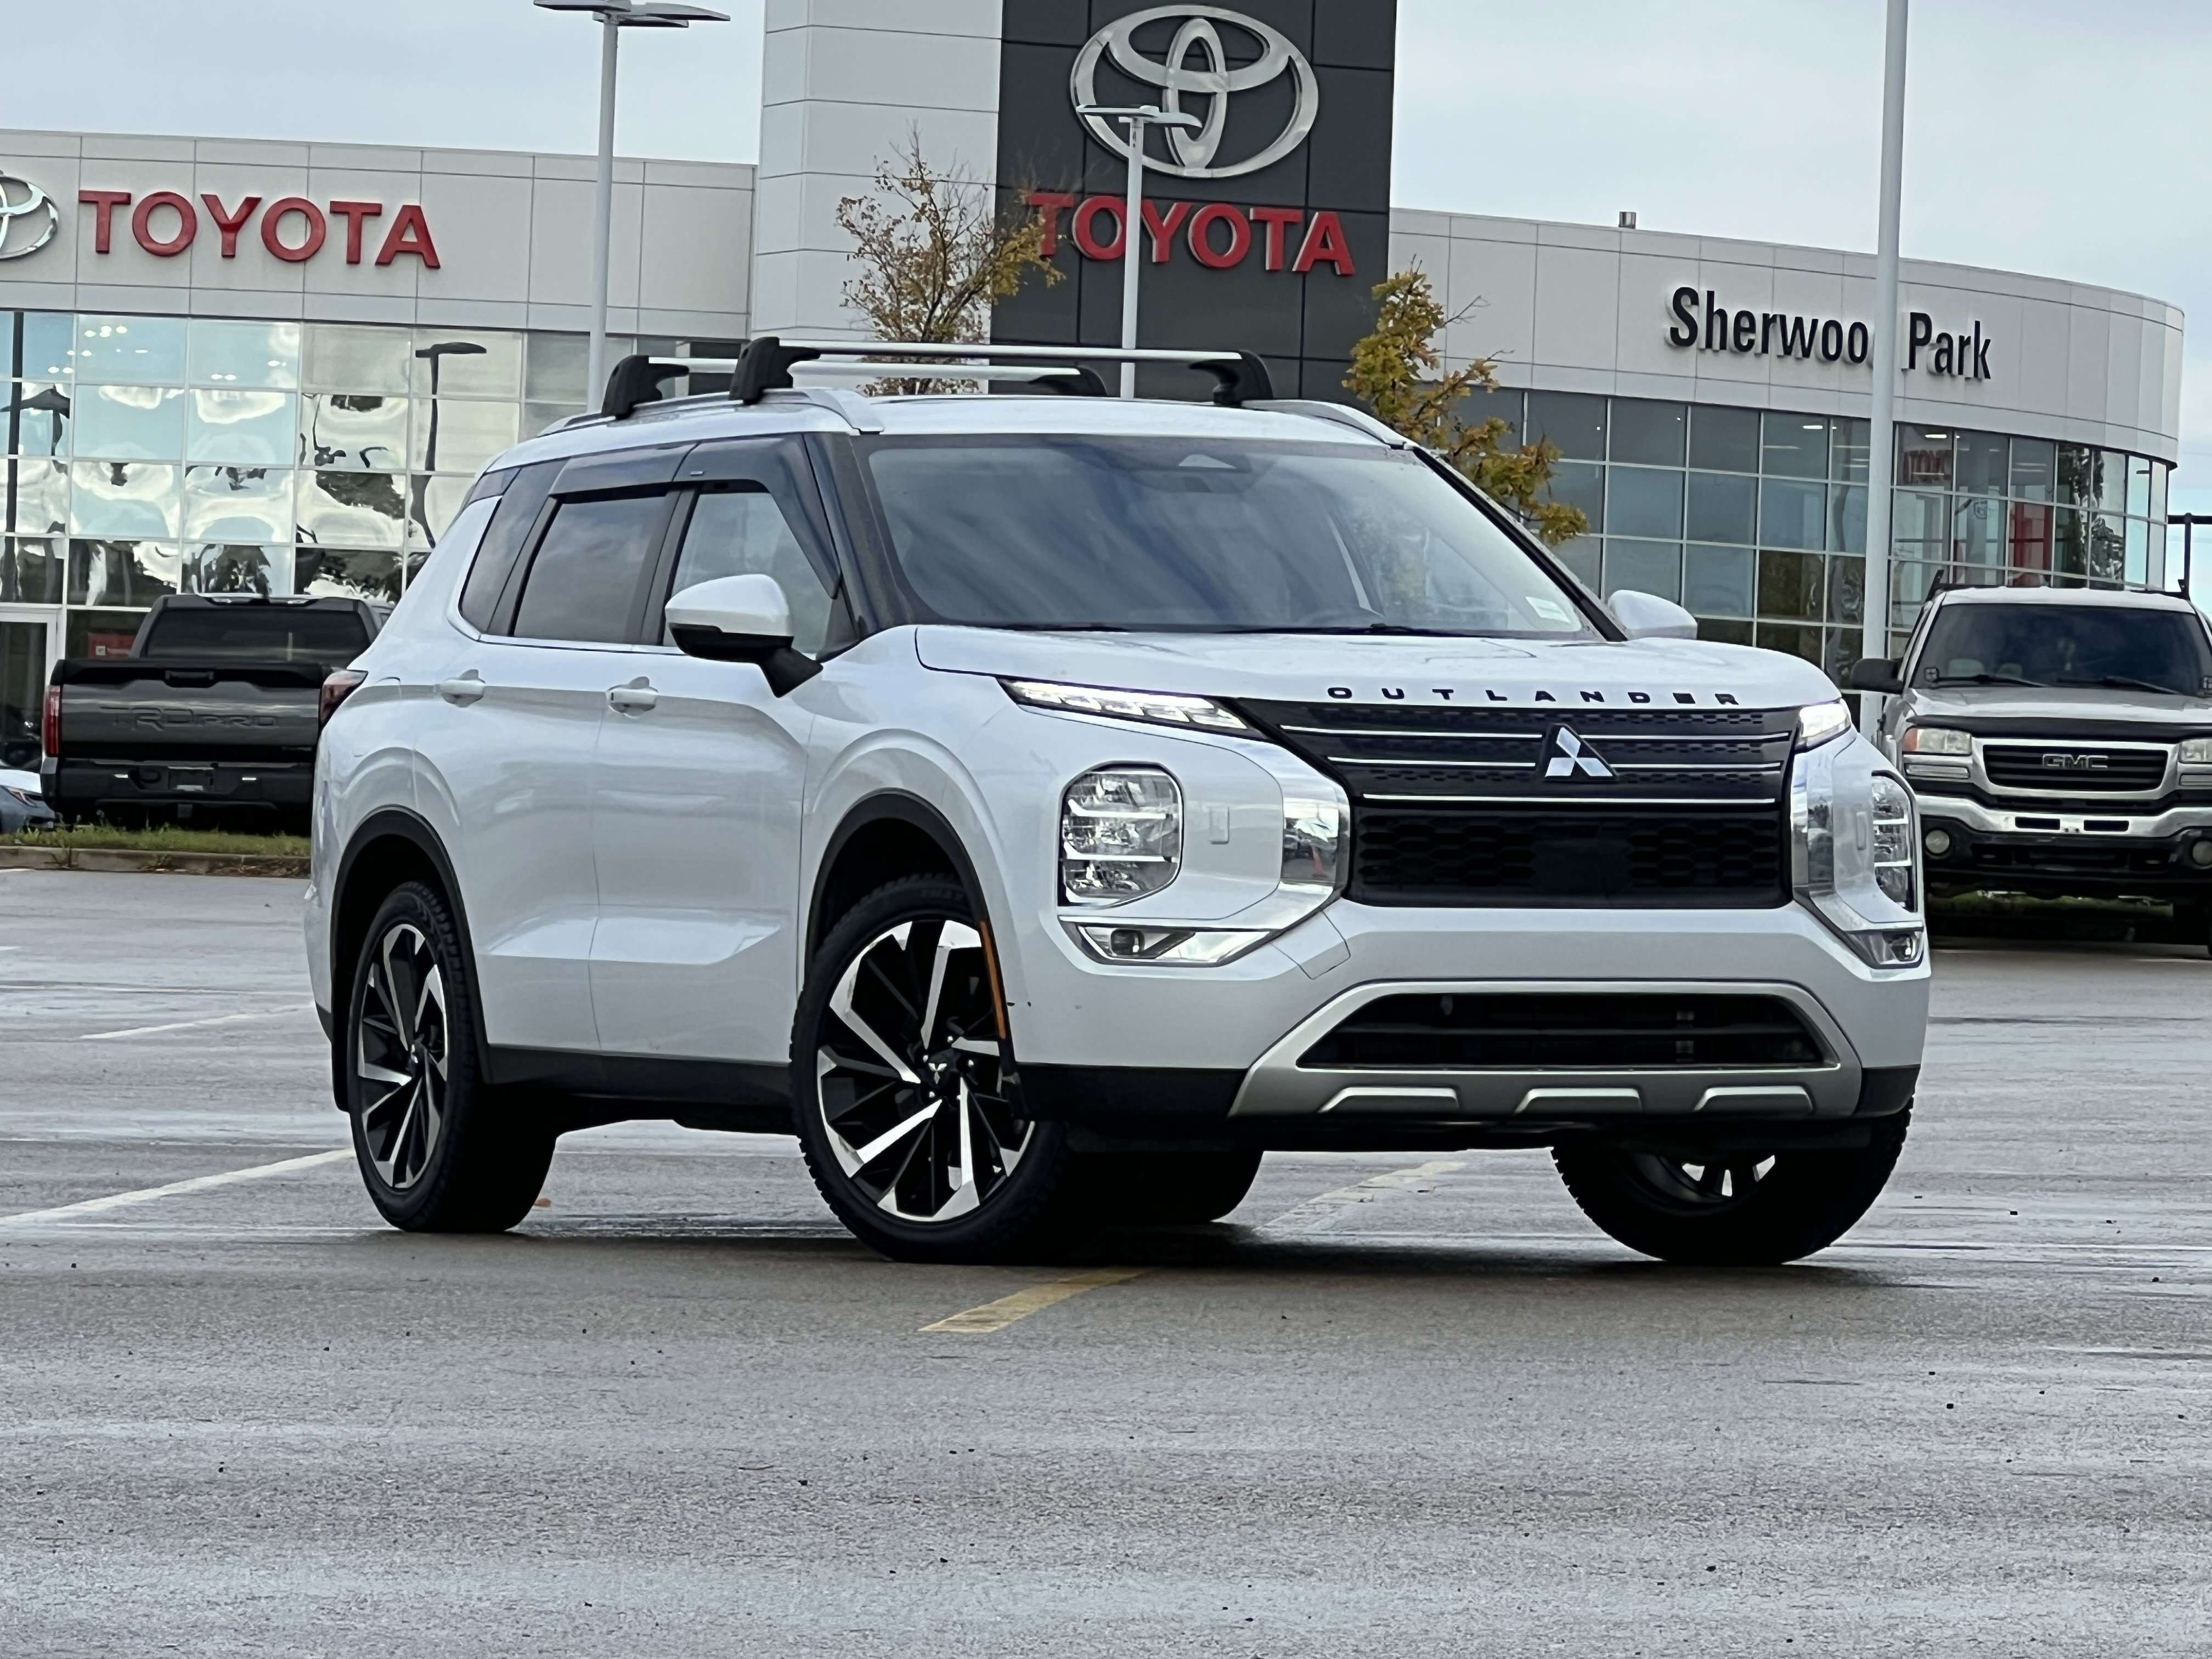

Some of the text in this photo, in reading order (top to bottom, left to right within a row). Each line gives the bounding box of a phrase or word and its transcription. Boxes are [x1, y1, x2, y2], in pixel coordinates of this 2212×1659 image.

[78, 190, 441, 269] TOYOTA
[1028, 193, 1356, 276] TOYOTA
[1669, 286, 1992, 380] Sherwoo Park
[2042, 753, 2109, 769] GMC
